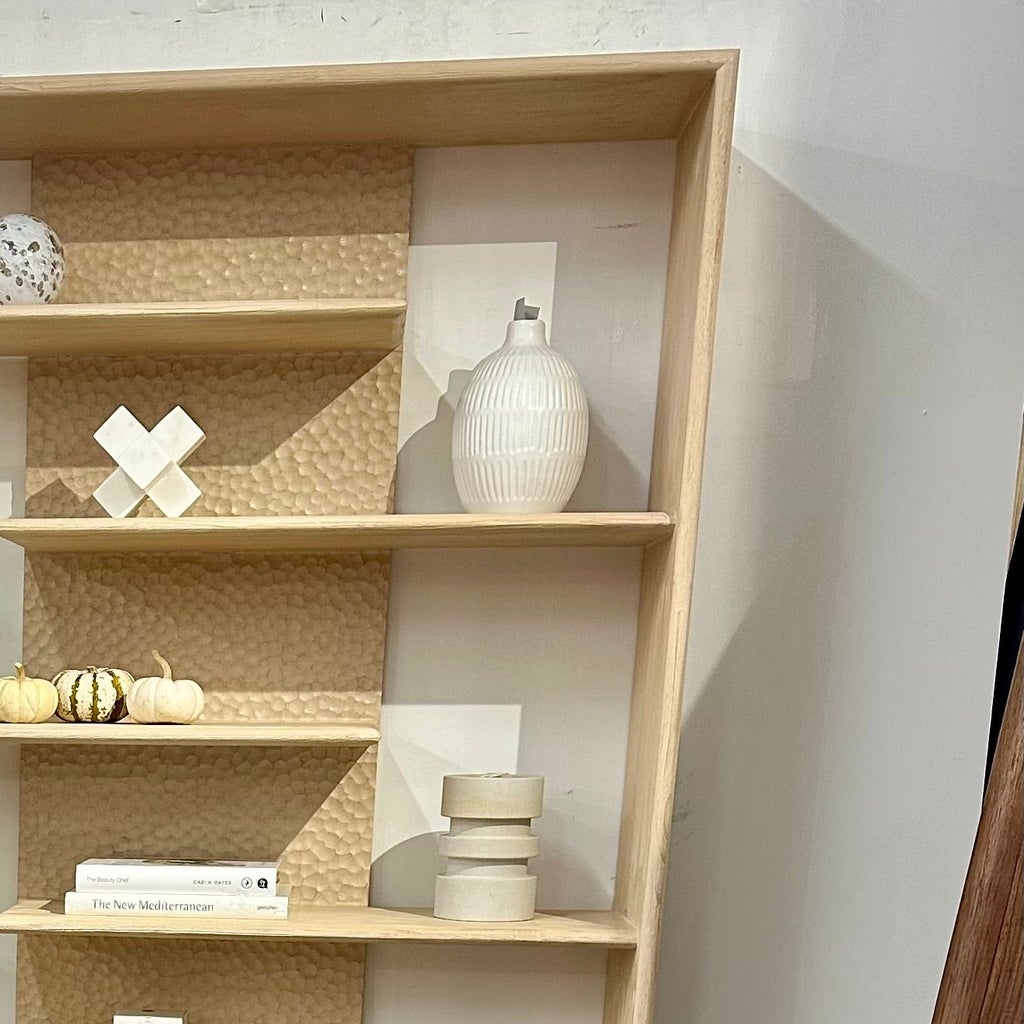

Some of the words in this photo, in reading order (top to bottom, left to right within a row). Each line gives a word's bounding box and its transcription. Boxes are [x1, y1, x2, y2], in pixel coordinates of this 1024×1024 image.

[91, 898, 111, 910] The
[113, 899, 136, 910] New
[138, 899, 214, 912] Mediterranean
